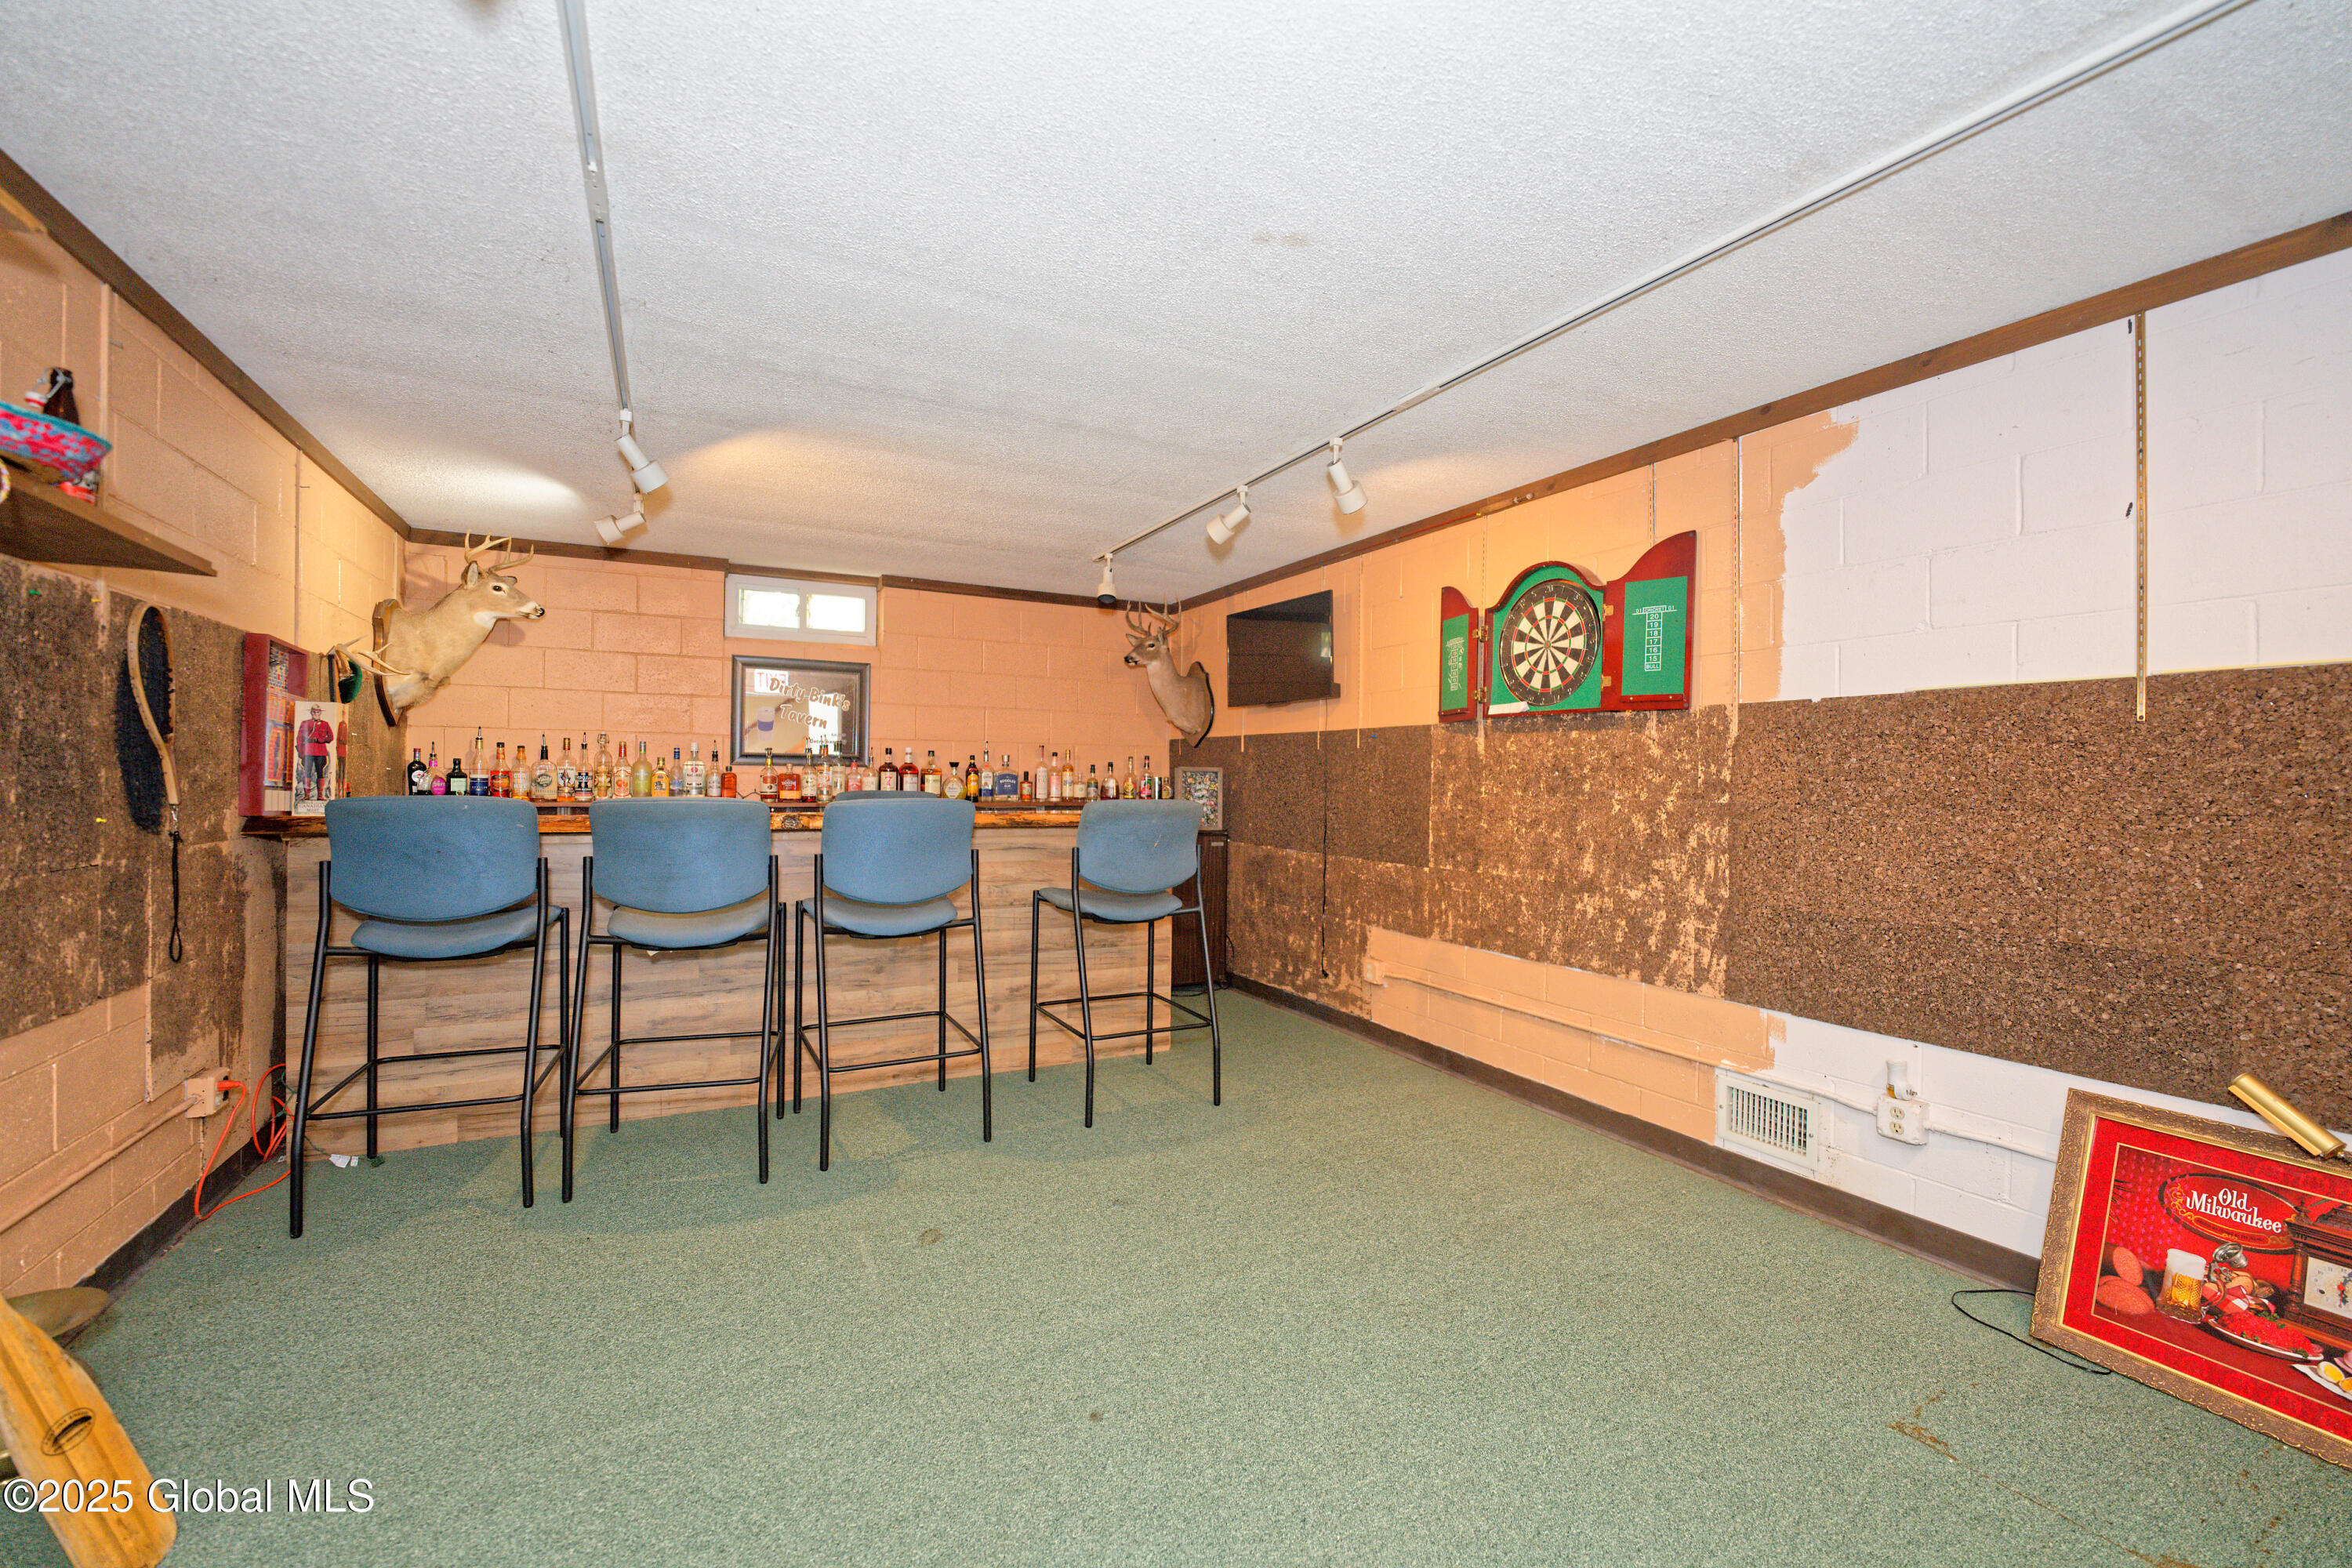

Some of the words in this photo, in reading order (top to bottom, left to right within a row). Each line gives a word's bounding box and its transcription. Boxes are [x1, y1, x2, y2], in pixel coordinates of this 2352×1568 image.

[768, 677, 806, 703] Dirty
[809, 685, 851, 711] Bink's
[779, 703, 828, 730] Tavern
[2186, 1189, 2282, 1234] Milwaukee
[2218, 1188, 2253, 1212] Old
